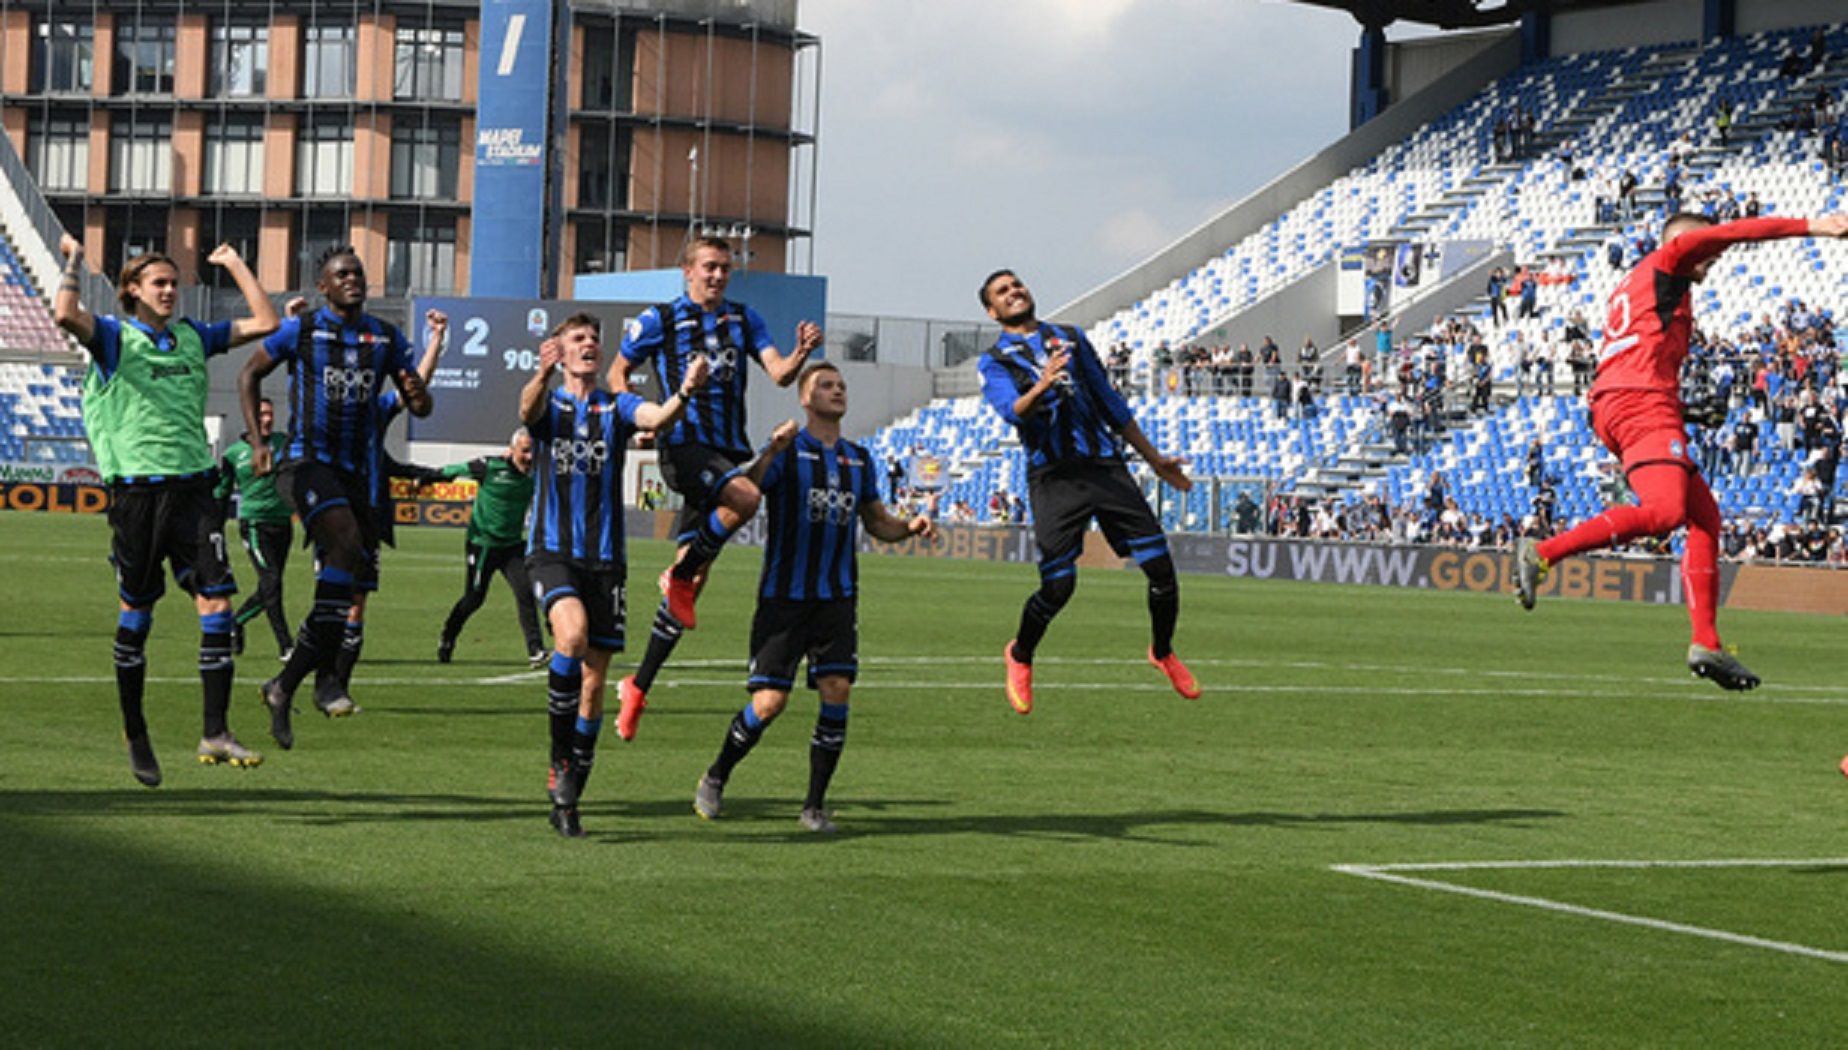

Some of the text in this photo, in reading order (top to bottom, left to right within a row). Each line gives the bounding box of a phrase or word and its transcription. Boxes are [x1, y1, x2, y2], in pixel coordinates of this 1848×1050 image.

[463, 316, 490, 356] 2
[0, 484, 108, 513] OLD
[424, 503, 473, 524] Gol
[1226, 542, 1277, 578] SU
